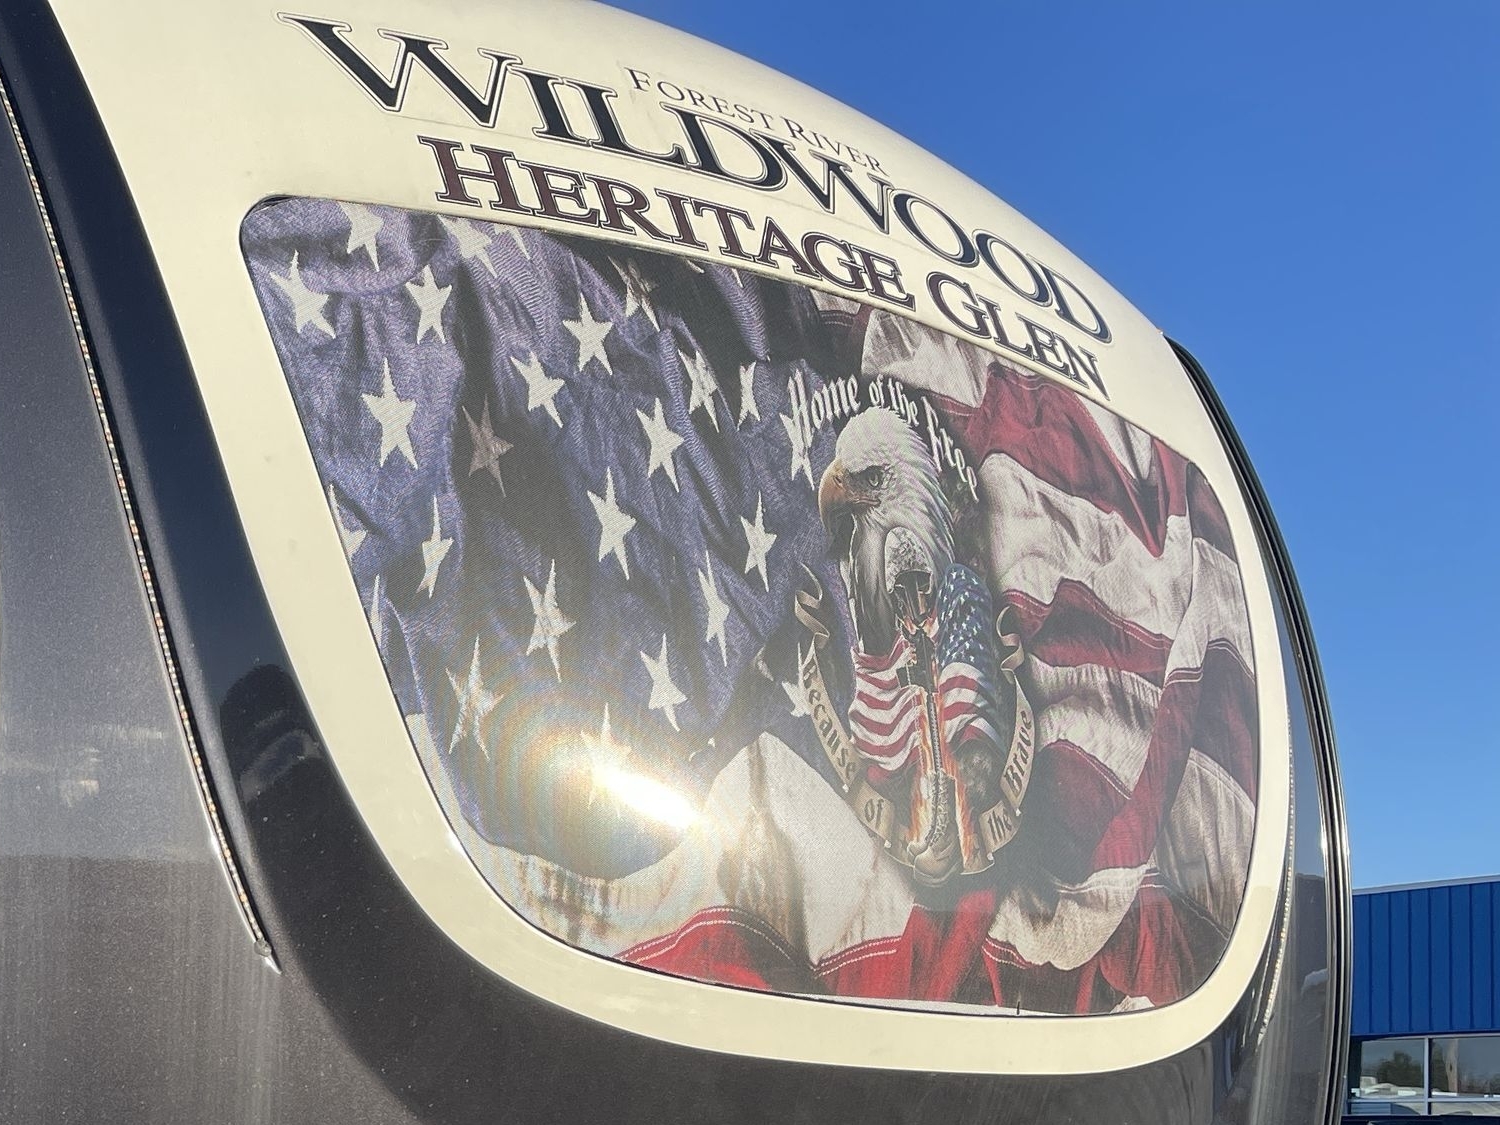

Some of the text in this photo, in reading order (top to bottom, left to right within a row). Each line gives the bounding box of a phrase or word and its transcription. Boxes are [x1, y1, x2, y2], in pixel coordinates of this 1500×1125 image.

[277, 11, 1112, 345] WILDWOOD
[624, 67, 889, 177] FOREST RIVER
[418, 136, 1110, 403] HERITAGE GLEN
[788, 369, 980, 503] Home of the Free
[803, 657, 857, 780] Because
[987, 807, 1013, 843] the
[1004, 710, 1033, 799] Brave
